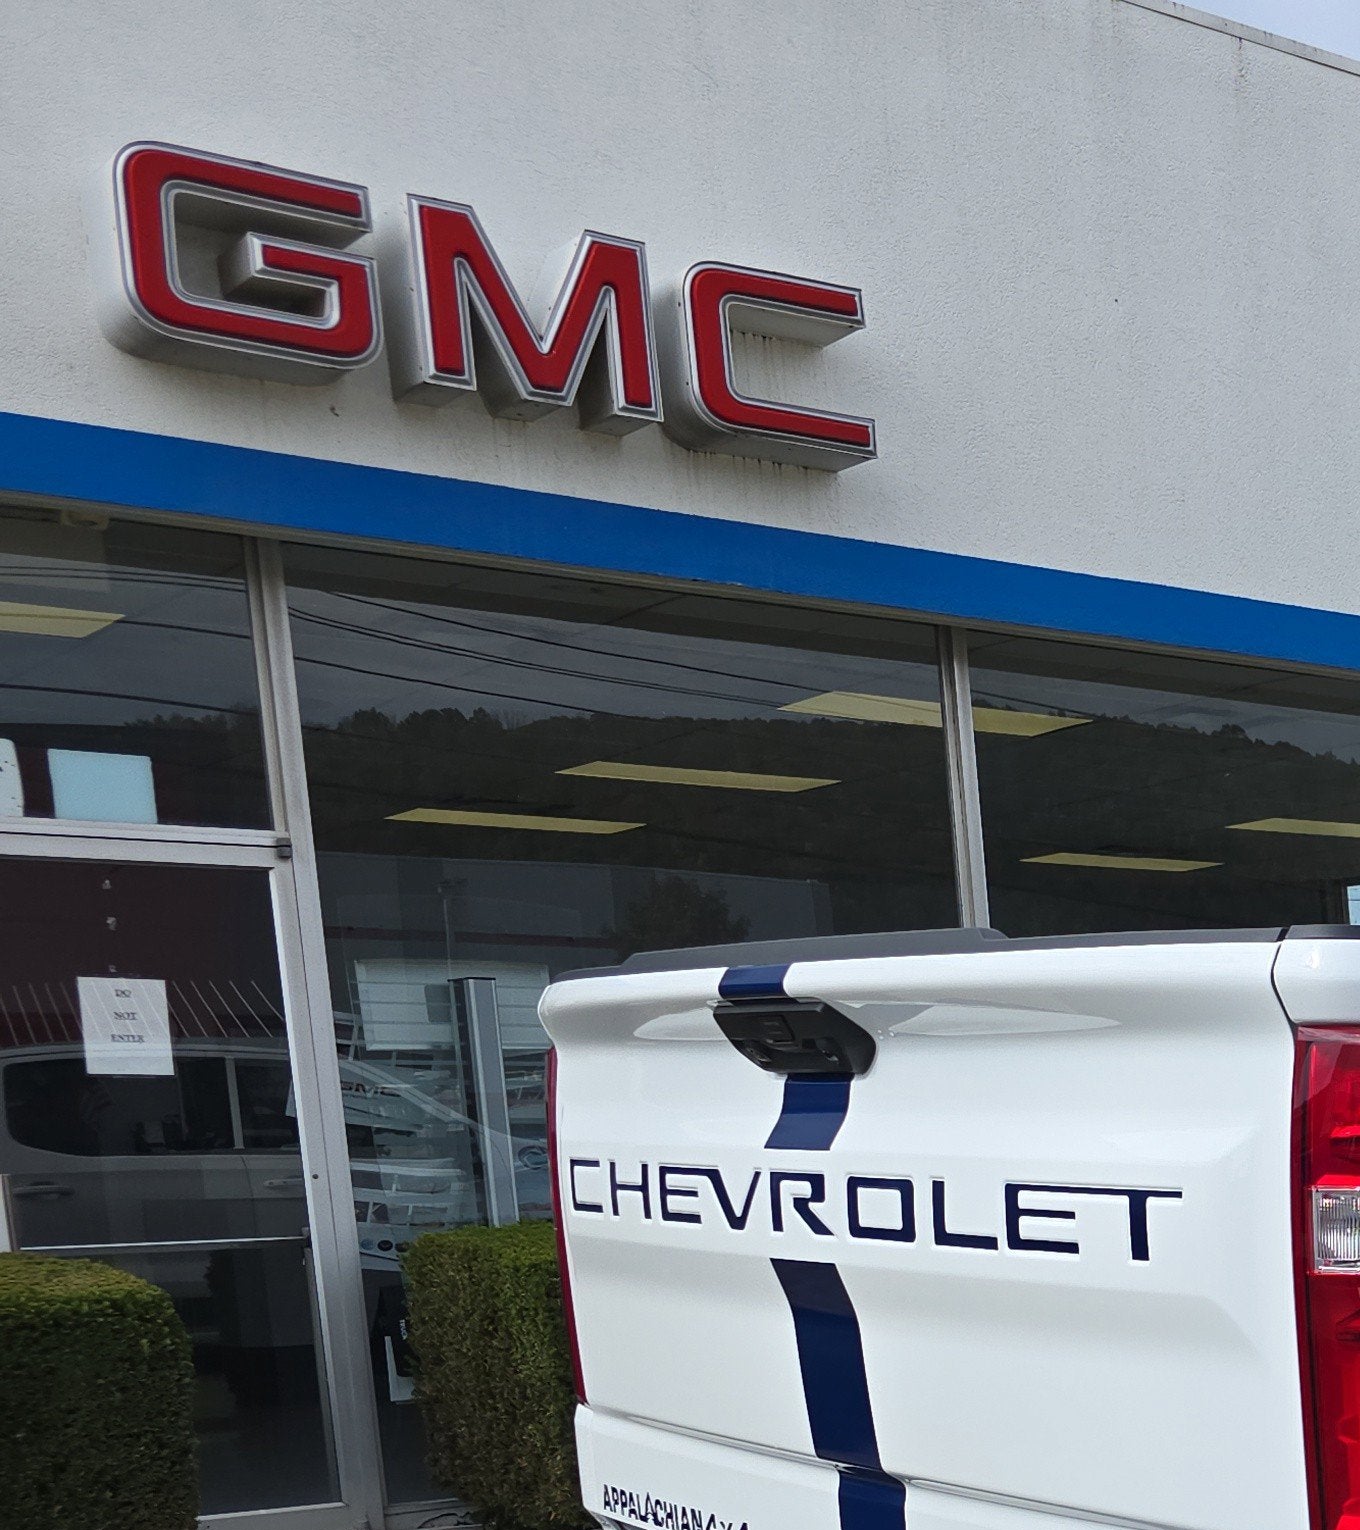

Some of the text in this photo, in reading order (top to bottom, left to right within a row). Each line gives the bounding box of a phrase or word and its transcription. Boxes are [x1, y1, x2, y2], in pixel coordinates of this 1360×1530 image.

[111, 140, 879, 460] GMC
[110, 1033, 146, 1044] ENTER
[113, 1011, 138, 1021] NOT
[568, 1158, 1184, 1263] CHEVROLET
